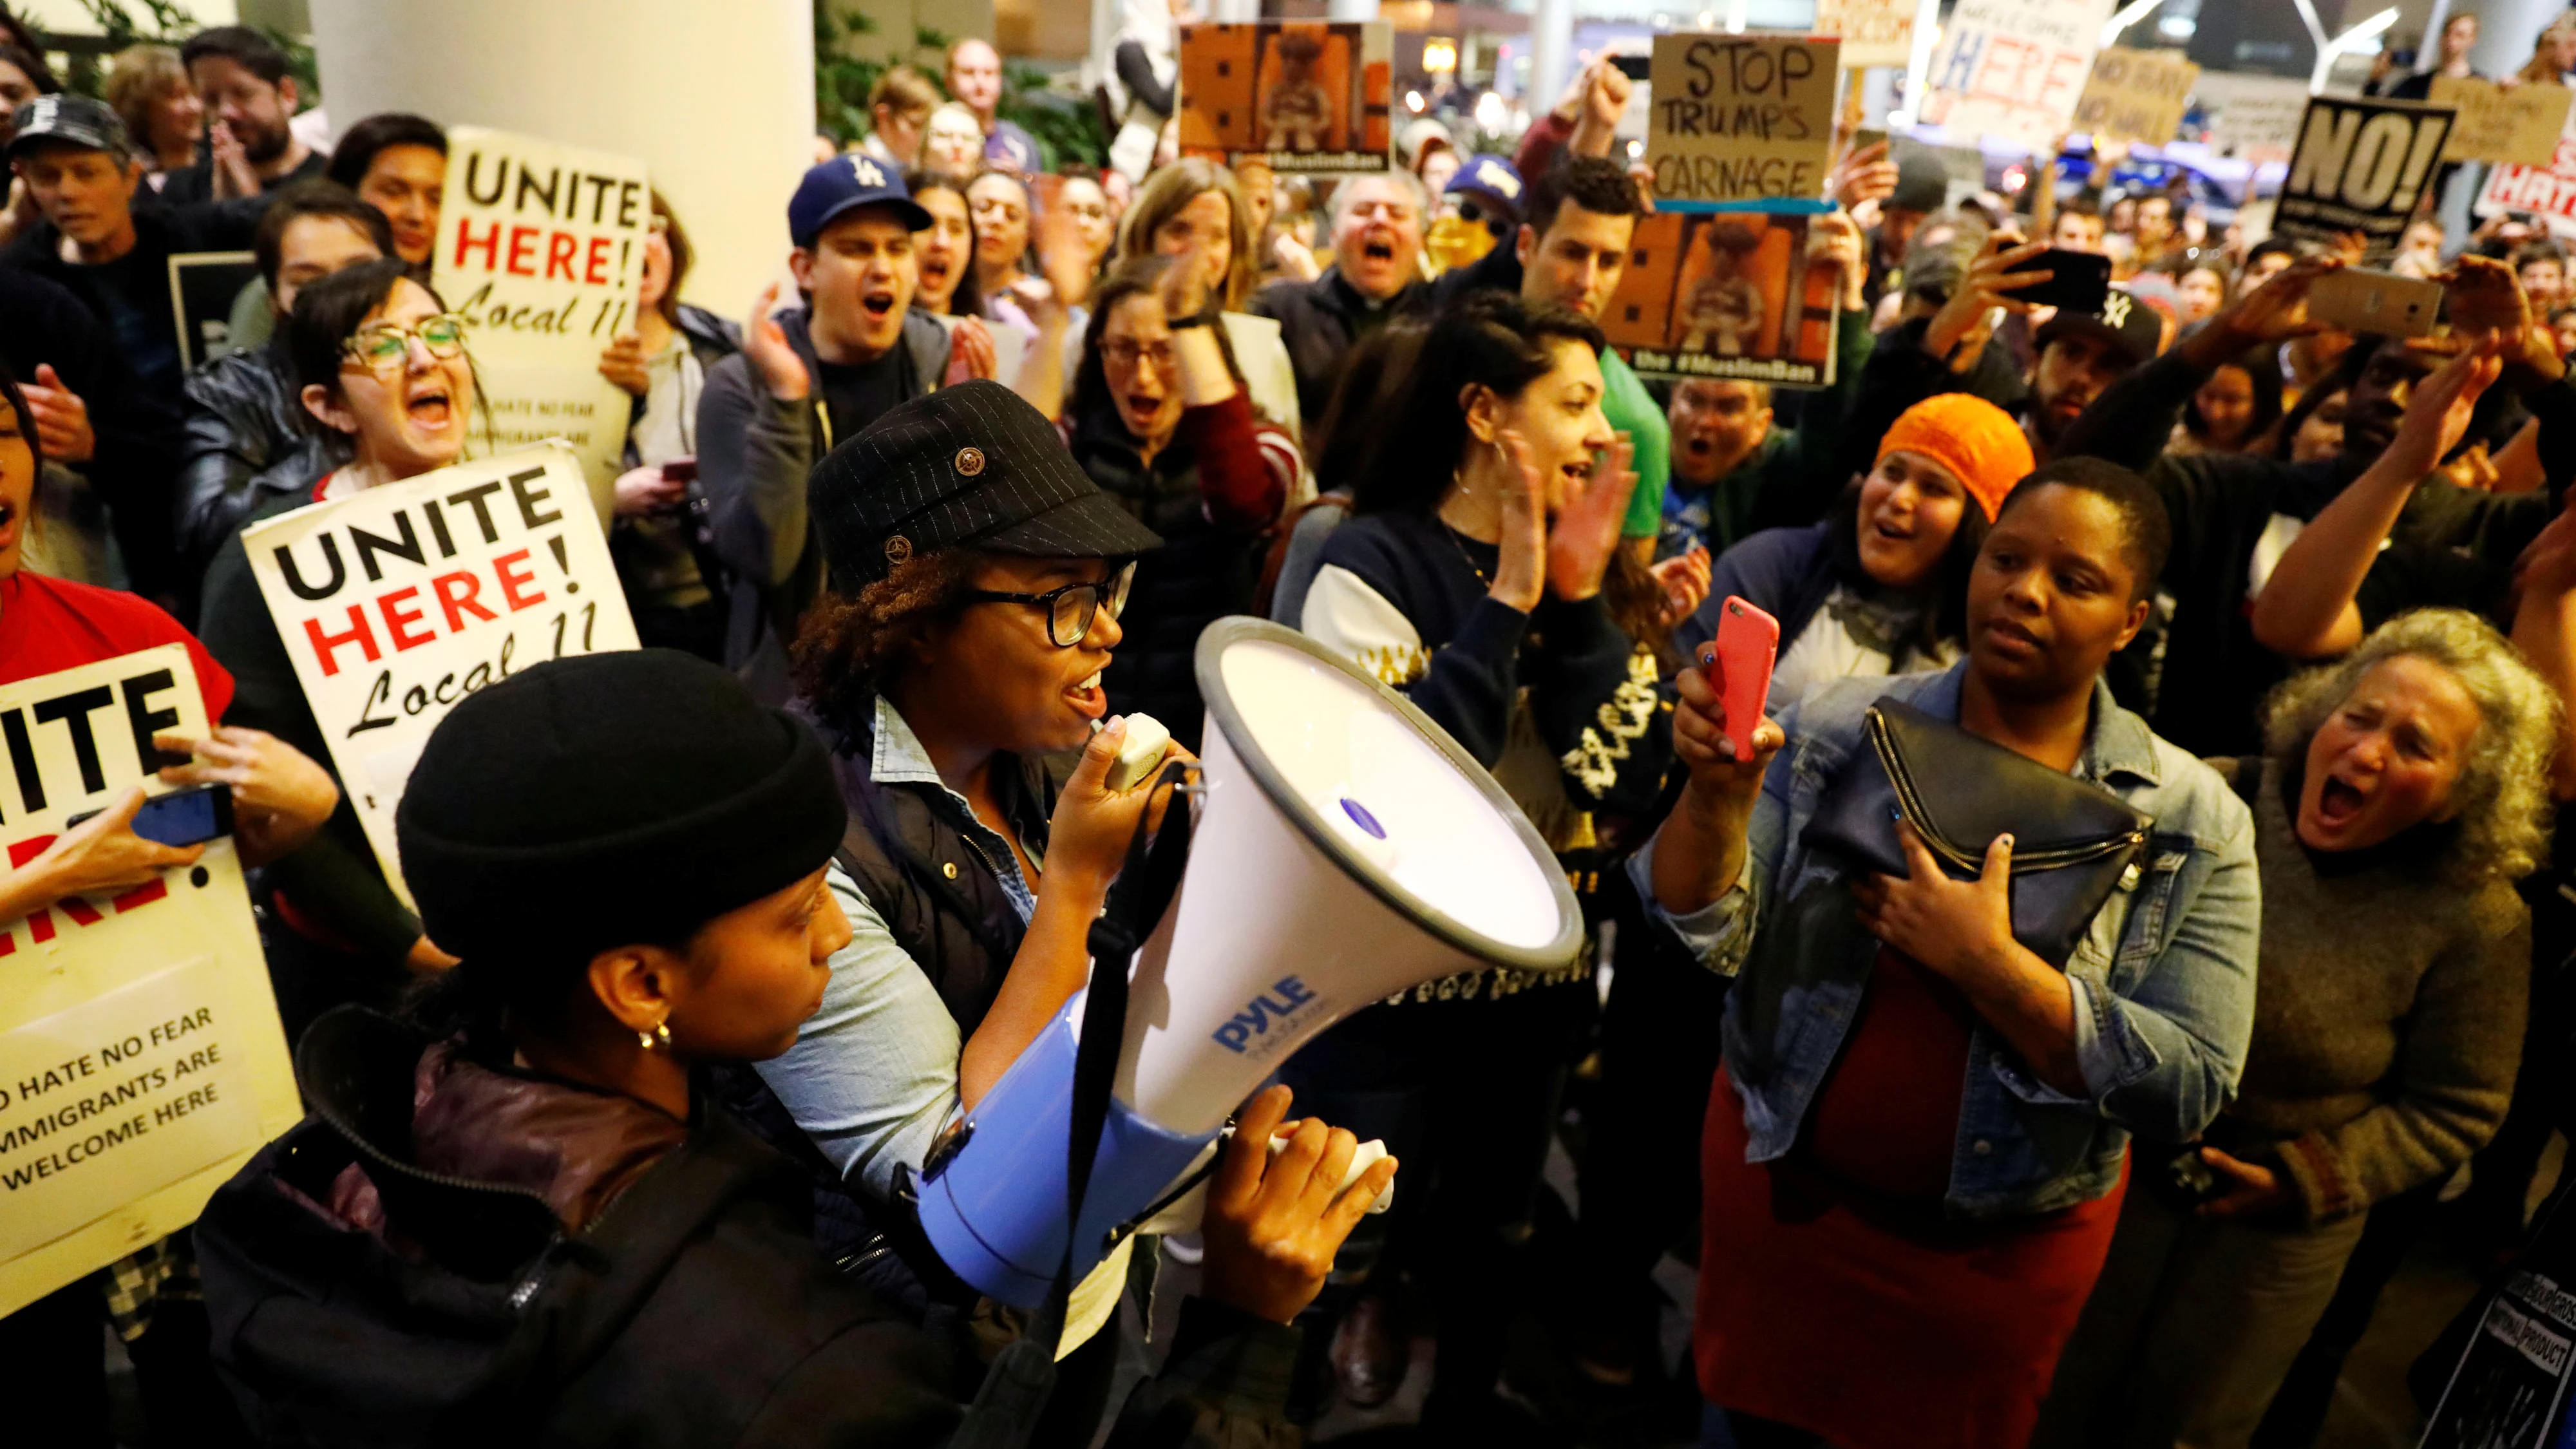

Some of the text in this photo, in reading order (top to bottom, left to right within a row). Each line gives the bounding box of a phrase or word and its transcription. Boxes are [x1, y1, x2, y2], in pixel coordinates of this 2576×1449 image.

[1685, 39, 1814, 99] STOP
[1942, 30, 2083, 108] HERE
[465, 152, 641, 227] UNITE
[849, 154, 887, 187] LA
[1653, 154, 1814, 198] CARNAGE
[2288, 106, 2448, 213] NO!
[454, 217, 630, 288] HERE!
[457, 280, 578, 334] Local
[1676, 353, 1816, 383] #MuslimBan
[273, 466, 564, 600] UNITE
[303, 535, 579, 677] HERE!
[346, 632, 522, 738] Local
[0, 668, 193, 821] ITE
[1212, 975, 1316, 1053] PYLE
[18, 1054, 95, 1101] HATE
[101, 1036, 142, 1068] NO
[149, 1007, 213, 1047] FEAR
[174, 1042, 222, 1080] ARE
[2, 1082, 220, 1191] WELCOME HERE
[2521, 1324, 2568, 1368] PRODUCT
